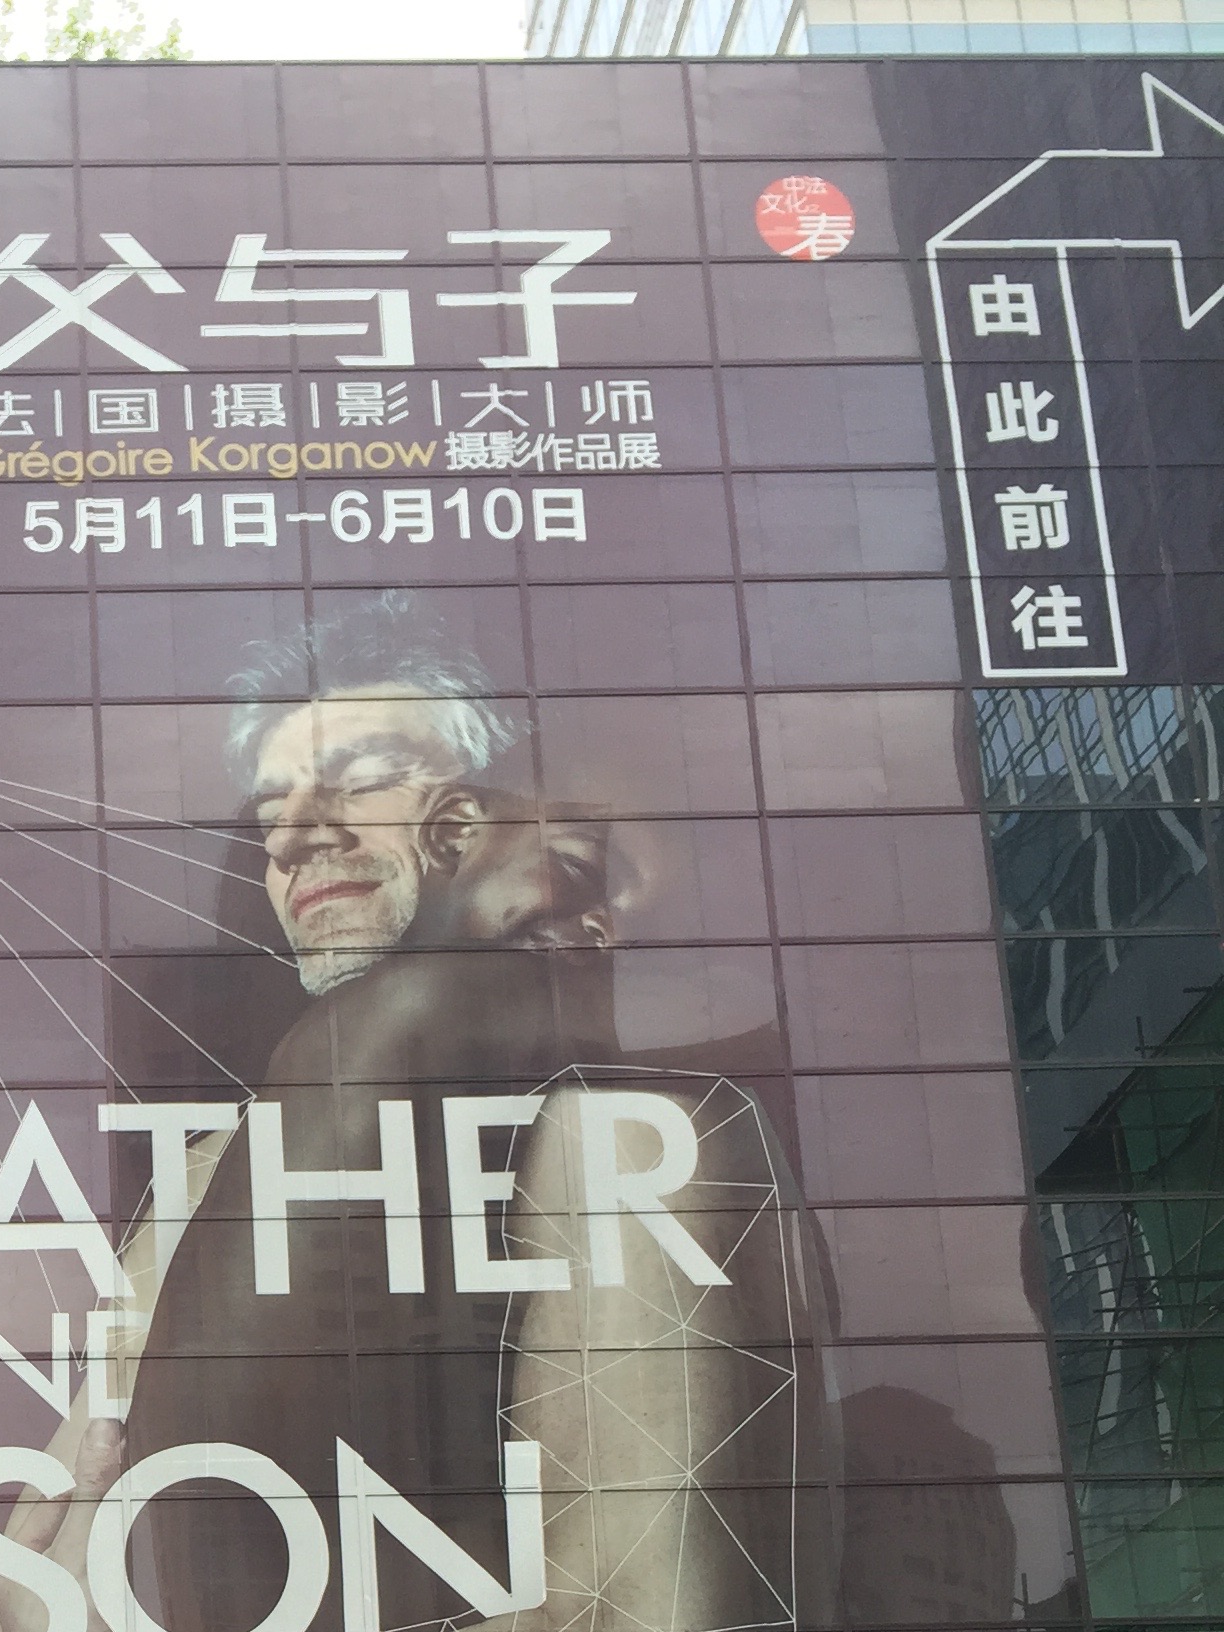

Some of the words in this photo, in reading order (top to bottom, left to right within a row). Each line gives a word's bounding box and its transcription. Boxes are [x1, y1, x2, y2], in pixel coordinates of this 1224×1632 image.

[782, 176, 828, 194] 中法
[780, 212, 855, 260] 春
[189, 436, 438, 478] Korganow
[443, 429, 663, 473] 摄影作品展
[969, 274, 1089, 651] 由此前往
